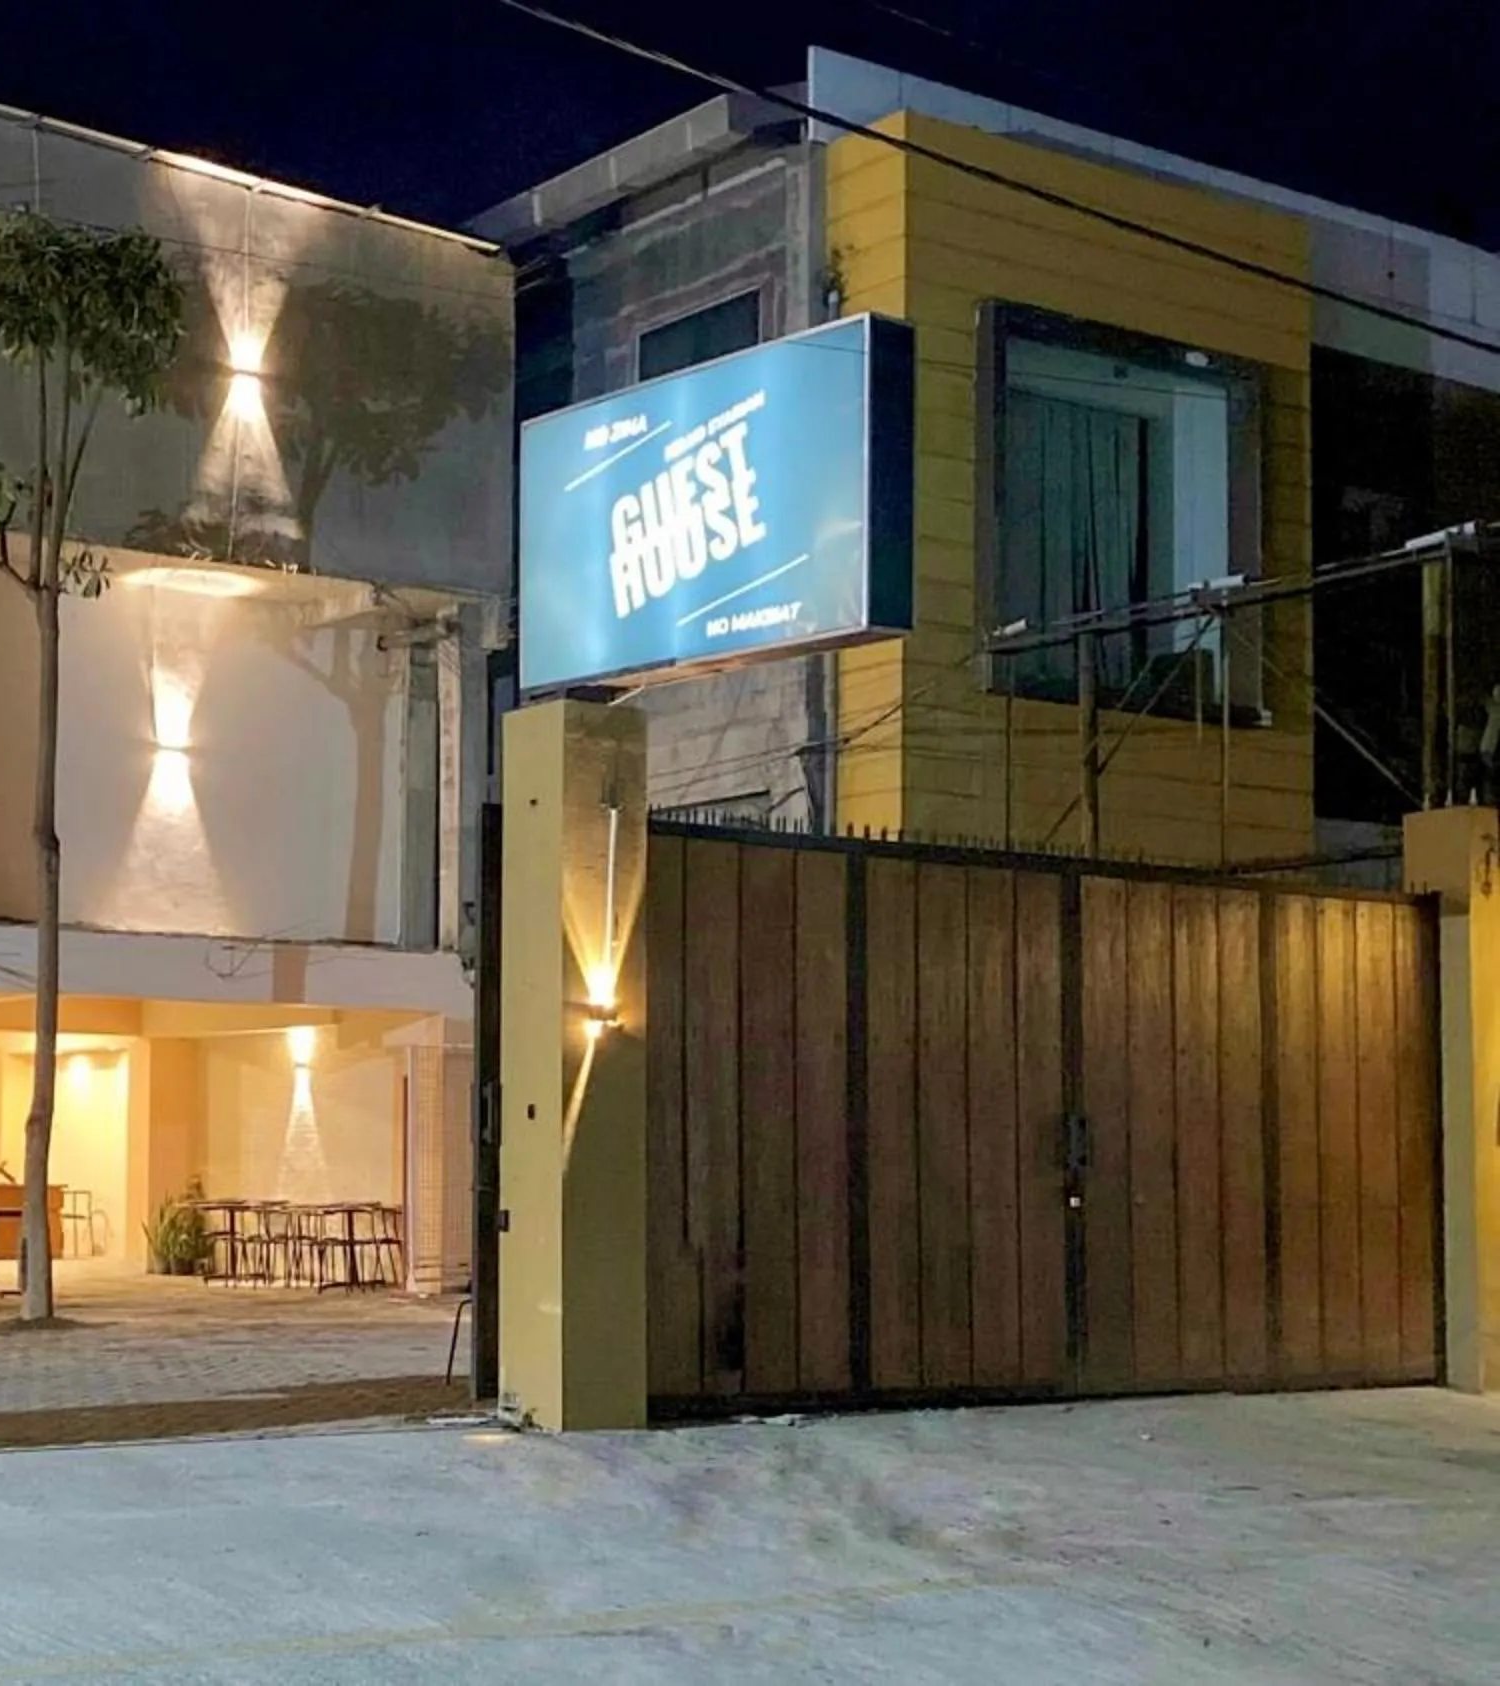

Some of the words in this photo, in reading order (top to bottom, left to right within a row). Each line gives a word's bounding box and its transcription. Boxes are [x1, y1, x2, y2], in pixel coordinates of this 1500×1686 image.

[609, 467, 767, 619] HOUSE
[611, 420, 749, 552] GUEST
[706, 616, 729, 638] NO
